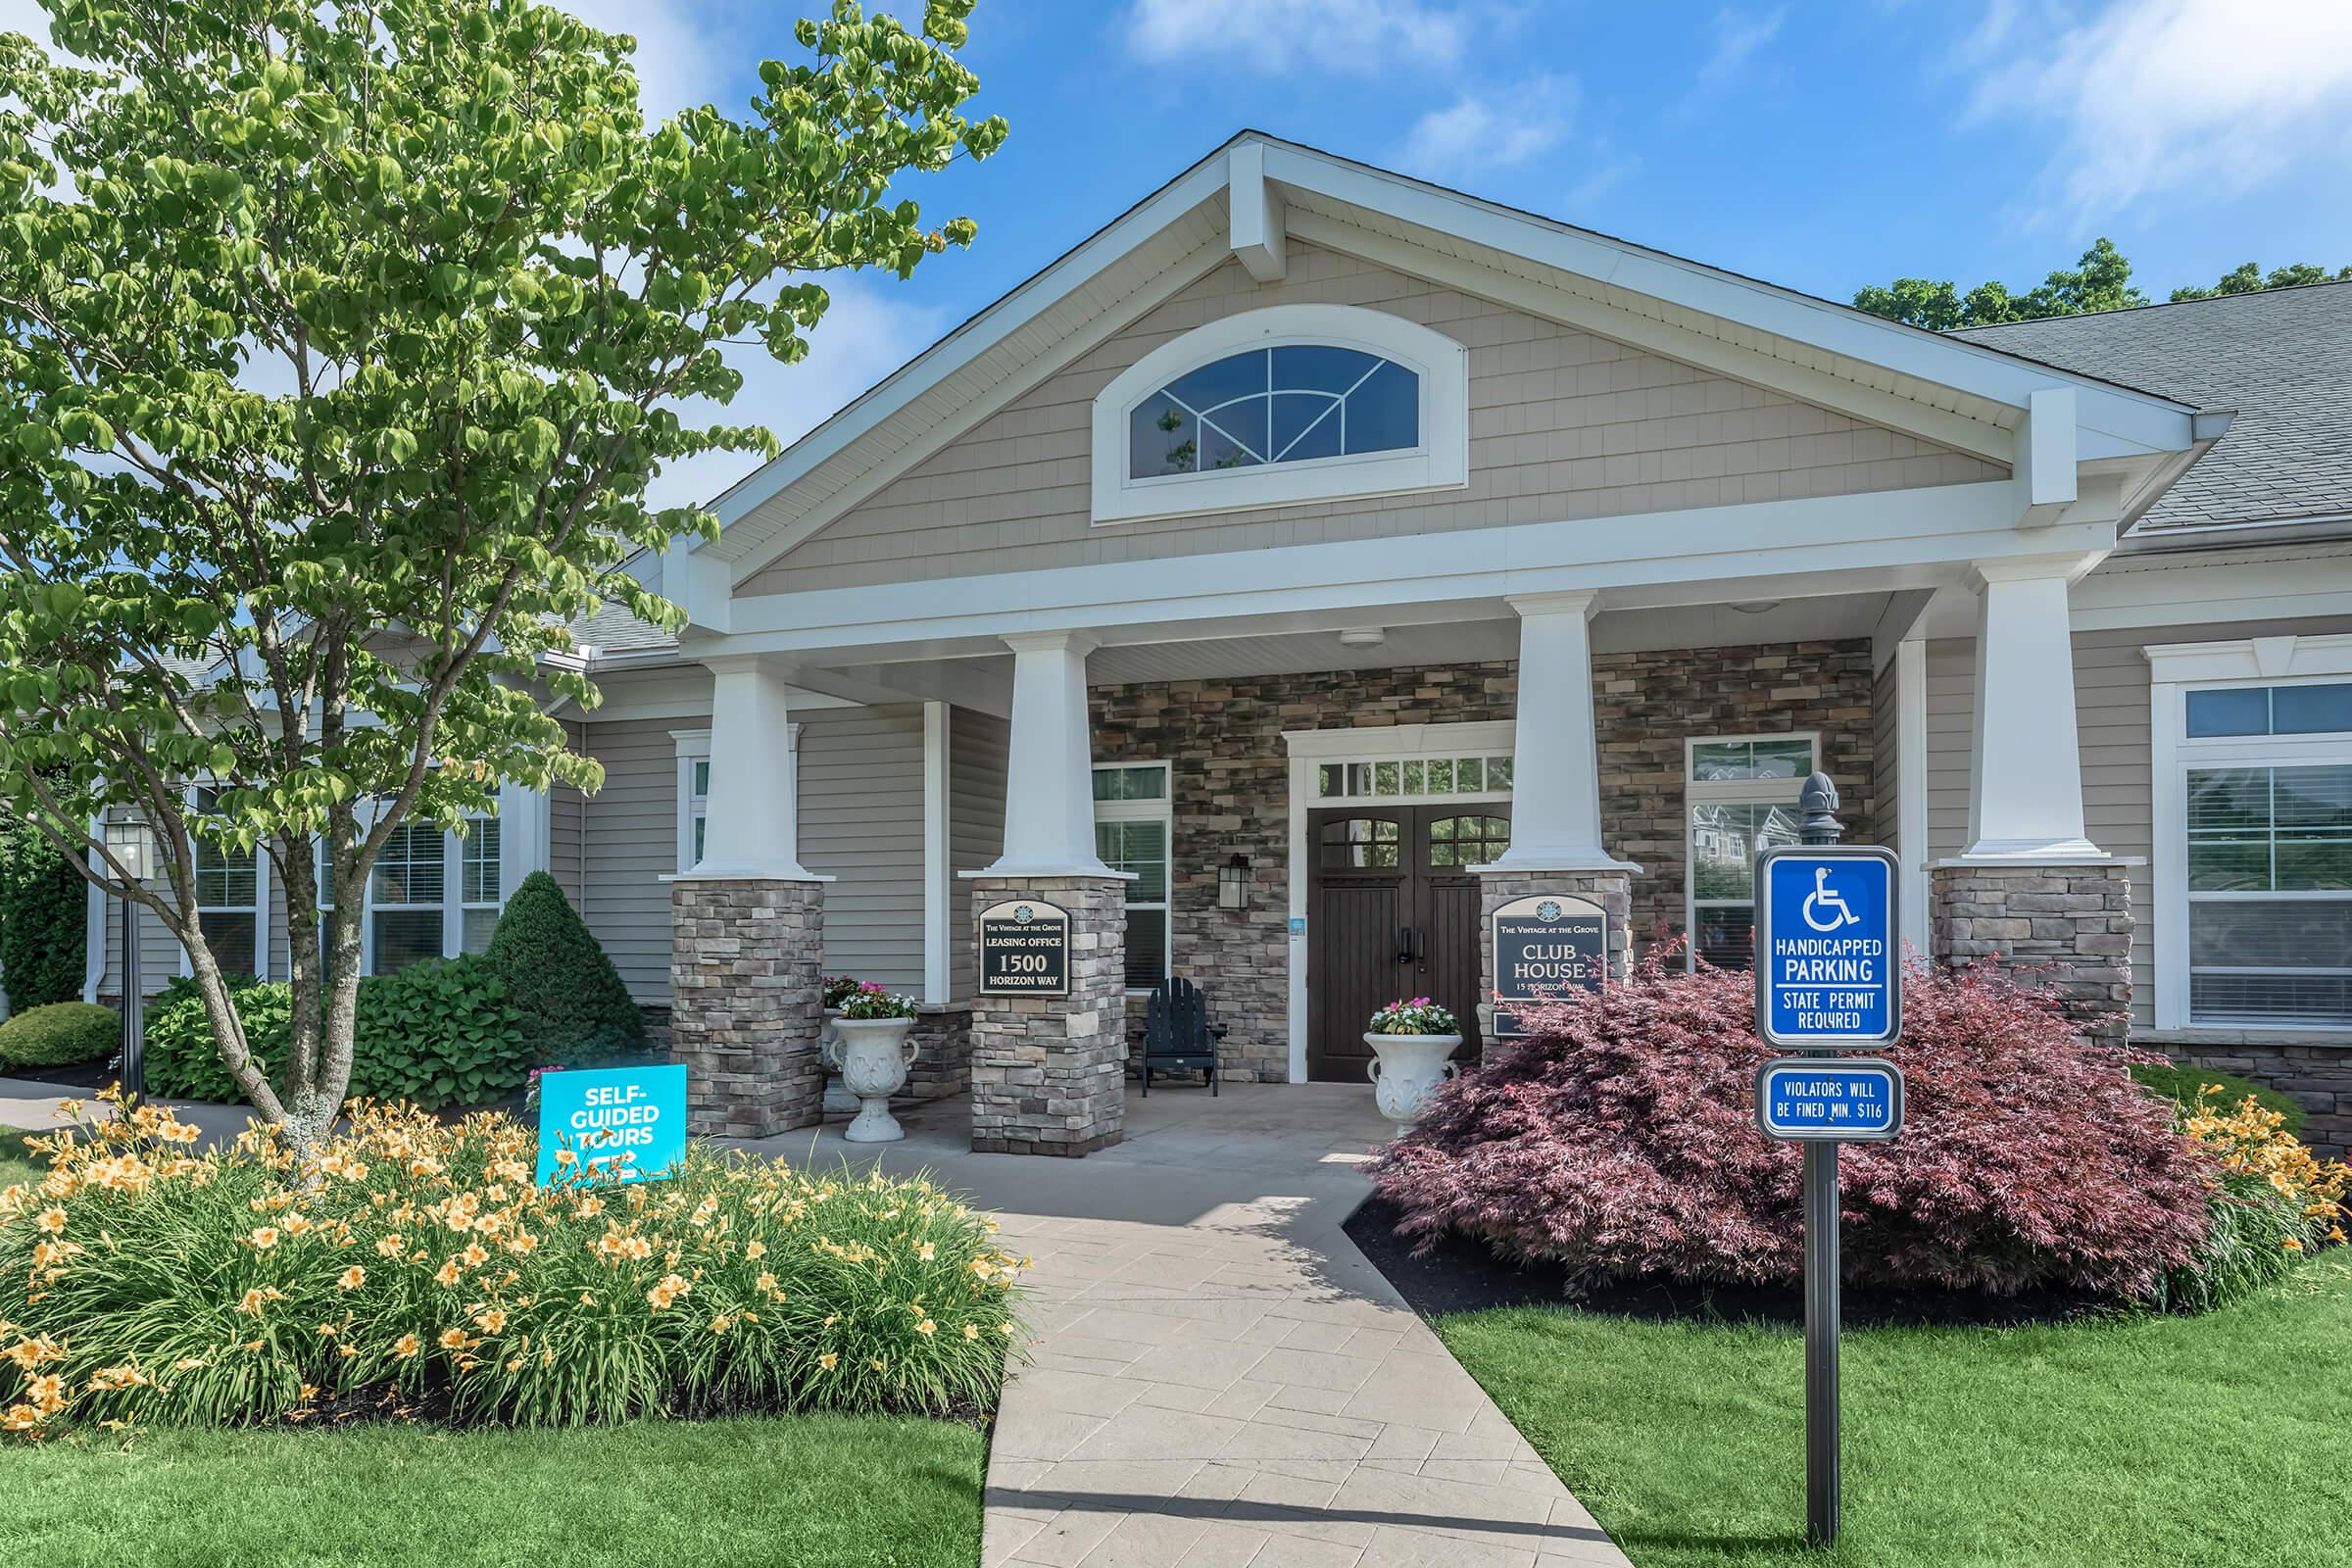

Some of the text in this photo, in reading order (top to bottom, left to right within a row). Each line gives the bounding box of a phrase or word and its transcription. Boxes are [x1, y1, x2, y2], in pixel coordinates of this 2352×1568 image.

[1573, 925, 1599, 933] GROVE
[986, 937, 1062, 947] LEASING OFFICE
[1776, 939, 1882, 956] HANDICAPPED
[1522, 944, 1576, 960] CLUB
[1000, 954, 1047, 972] 1500
[1514, 963, 1586, 979] HOUSE
[1786, 959, 1873, 981] PARKING
[989, 976, 1058, 985] HORIZON WAY
[1783, 992, 1875, 1009] STATE PERMIT
[1798, 1012, 1860, 1029] REQUIRED
[585, 1085, 647, 1106] SELF-
[1785, 1081, 1874, 1098] VIOLATORS WILL
[570, 1105, 660, 1129] GUIDED
[1777, 1102, 1882, 1119] BE FINED MIN. $116
[575, 1127, 654, 1150] TOURS
